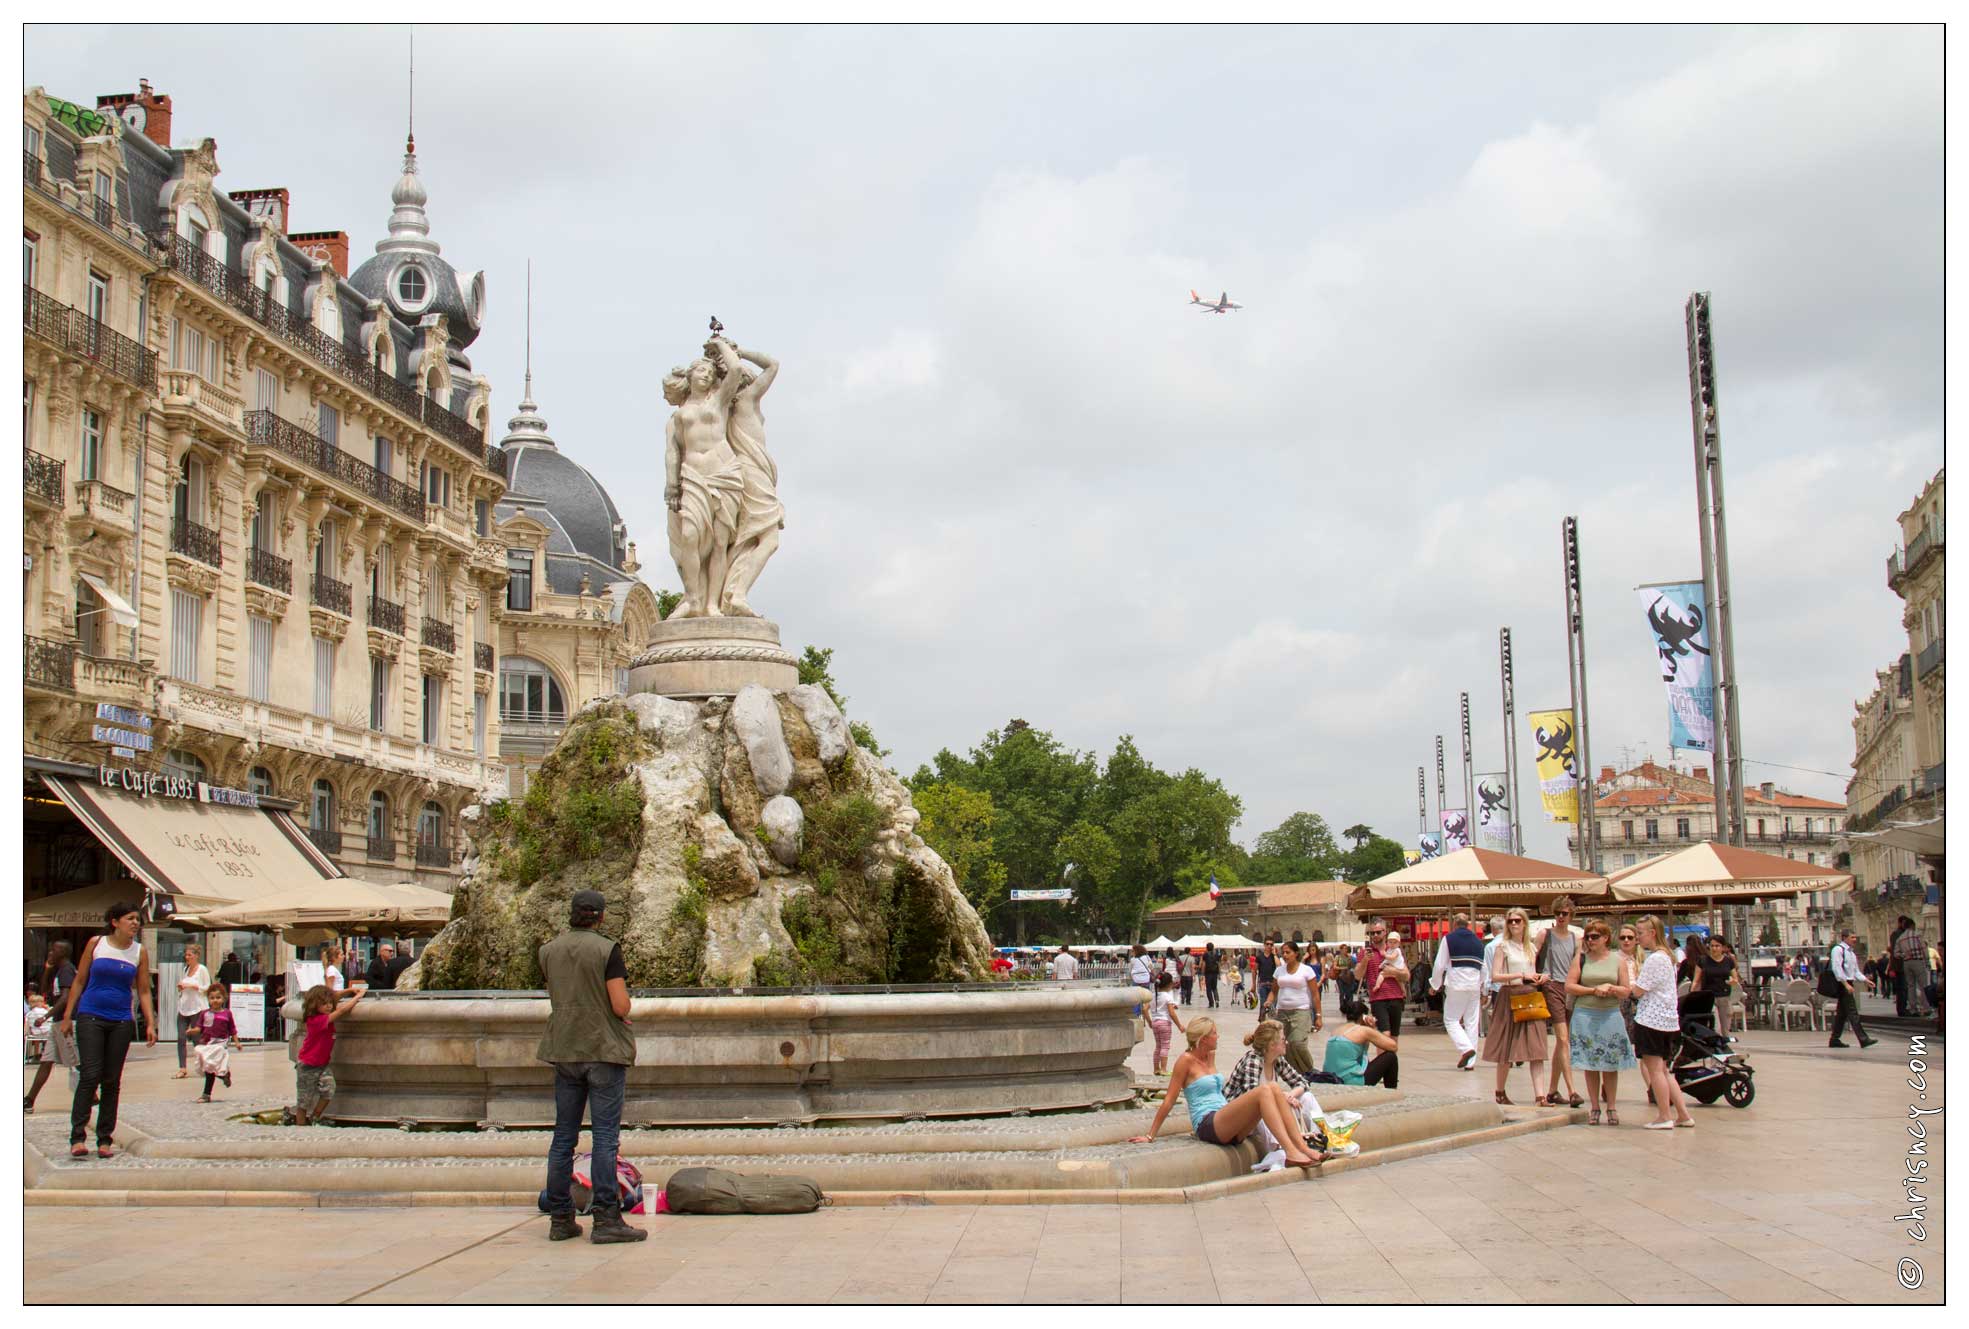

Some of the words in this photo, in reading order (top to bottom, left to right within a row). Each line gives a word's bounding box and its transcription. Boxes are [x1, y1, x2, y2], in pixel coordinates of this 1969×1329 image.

[99, 704, 138, 727] AGENCE
[121, 766, 159, 799] Café
[163, 775, 193, 800] 1893
[183, 833, 219, 857] Café
[216, 837, 261, 857] Riche
[215, 861, 254, 878] 1893
[1396, 884, 1460, 894] BRASSERIE
[1469, 883, 1490, 891] LES
[1497, 881, 1532, 890] TROIS
[1537, 880, 1584, 890] GRACES
[1640, 884, 1705, 896] BRASSERIE
[1713, 882, 1735, 892] LES
[1741, 880, 1777, 890] TROIS
[1782, 879, 1831, 889] GRACES
